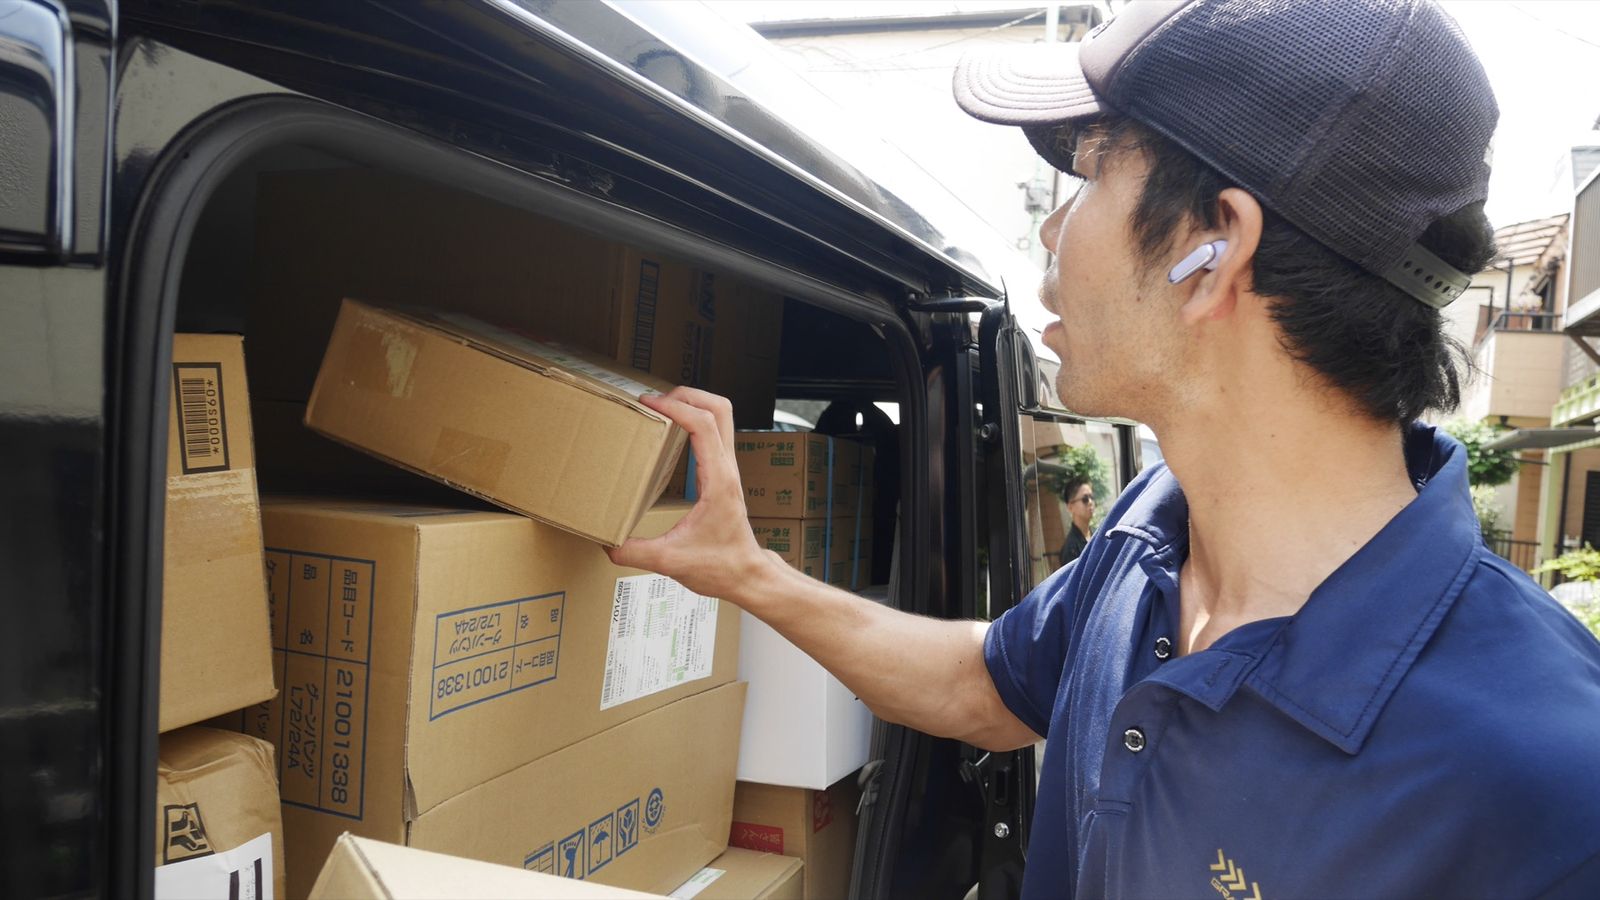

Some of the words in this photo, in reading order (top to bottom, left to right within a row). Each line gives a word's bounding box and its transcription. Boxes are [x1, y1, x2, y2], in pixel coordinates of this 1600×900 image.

[340, 568, 358, 653] 品目コード
[455, 612, 501, 636] L72/24A
[449, 629, 503, 655] グーンパンツ
[515, 650, 555, 674] 品目コード
[437, 660, 509, 699] 21001338
[288, 686, 303, 769] L72/24A
[303, 683, 319, 779] グーンパンツ
[331, 668, 353, 804] 21001338
